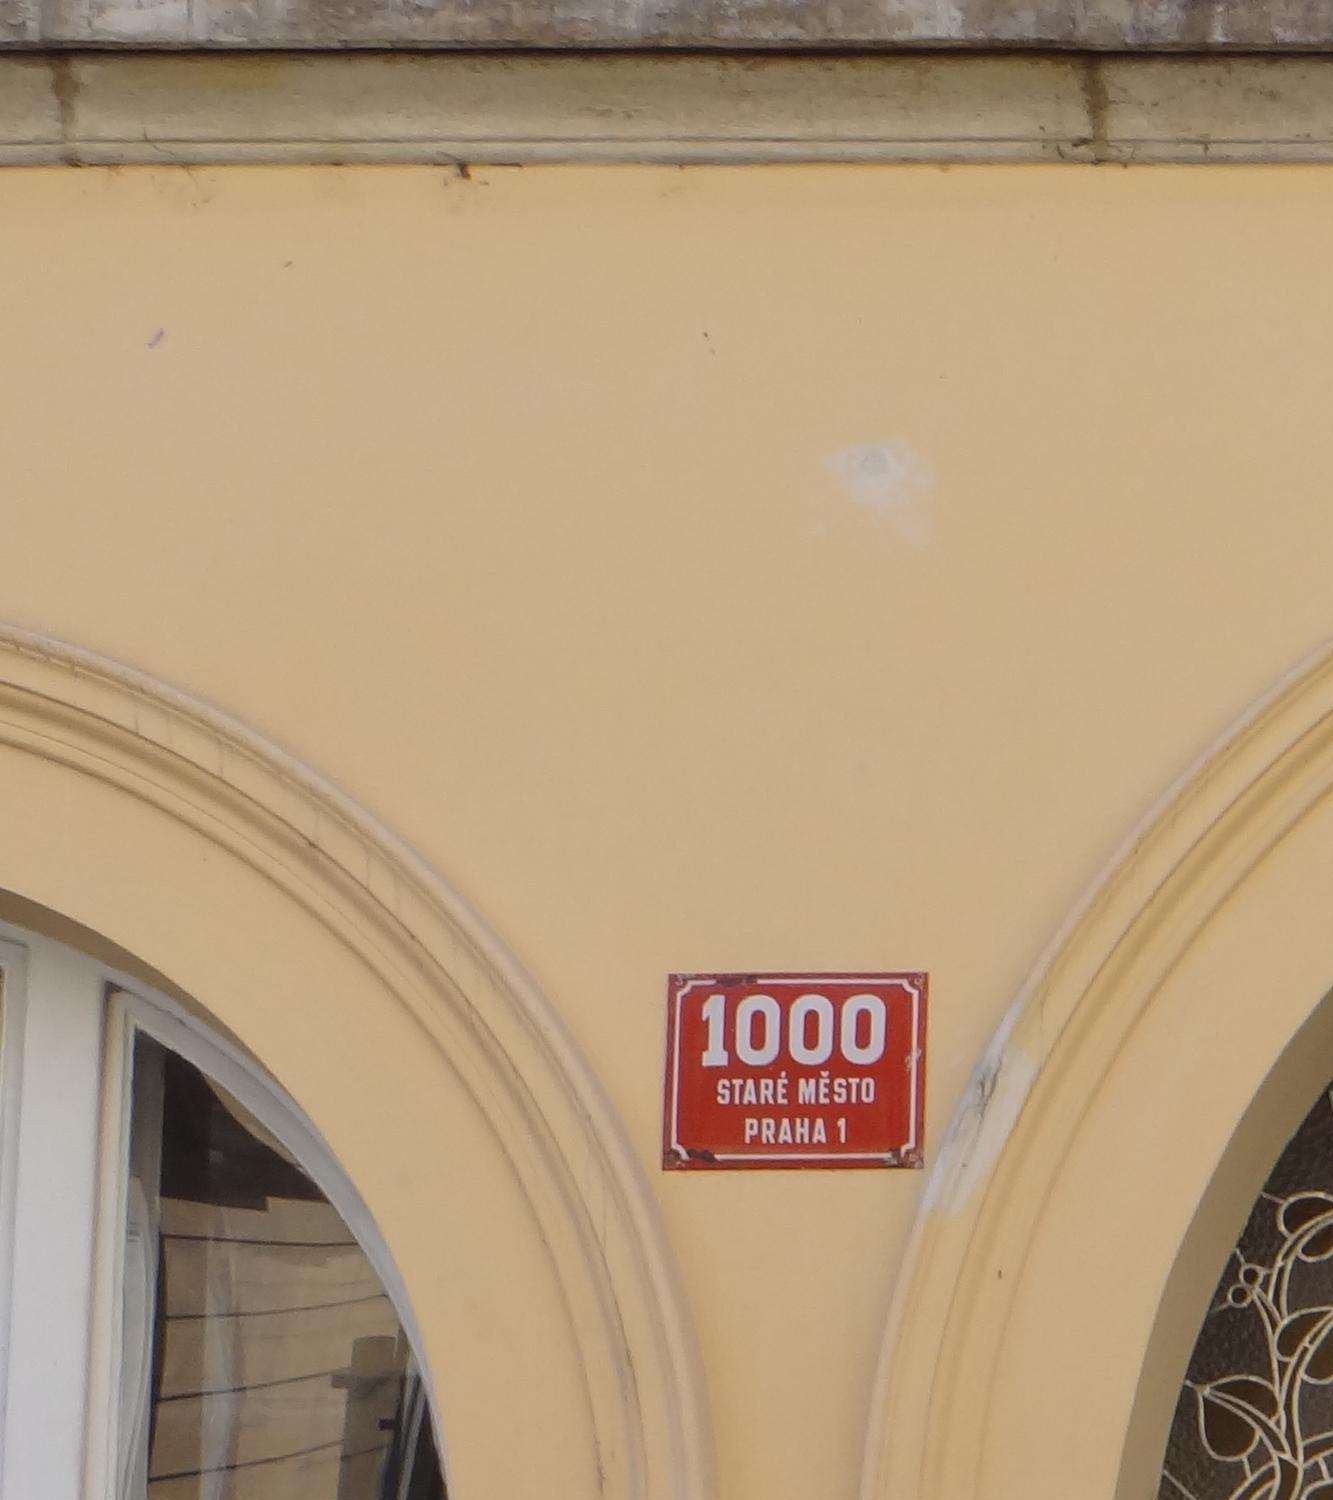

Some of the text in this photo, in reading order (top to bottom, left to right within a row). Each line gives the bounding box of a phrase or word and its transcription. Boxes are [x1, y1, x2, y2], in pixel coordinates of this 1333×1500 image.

[702, 994, 886, 1067] 1000
[716, 1071, 876, 1105] STARÉ MĚSTO
[744, 1117, 847, 1144] PRAHA 1
